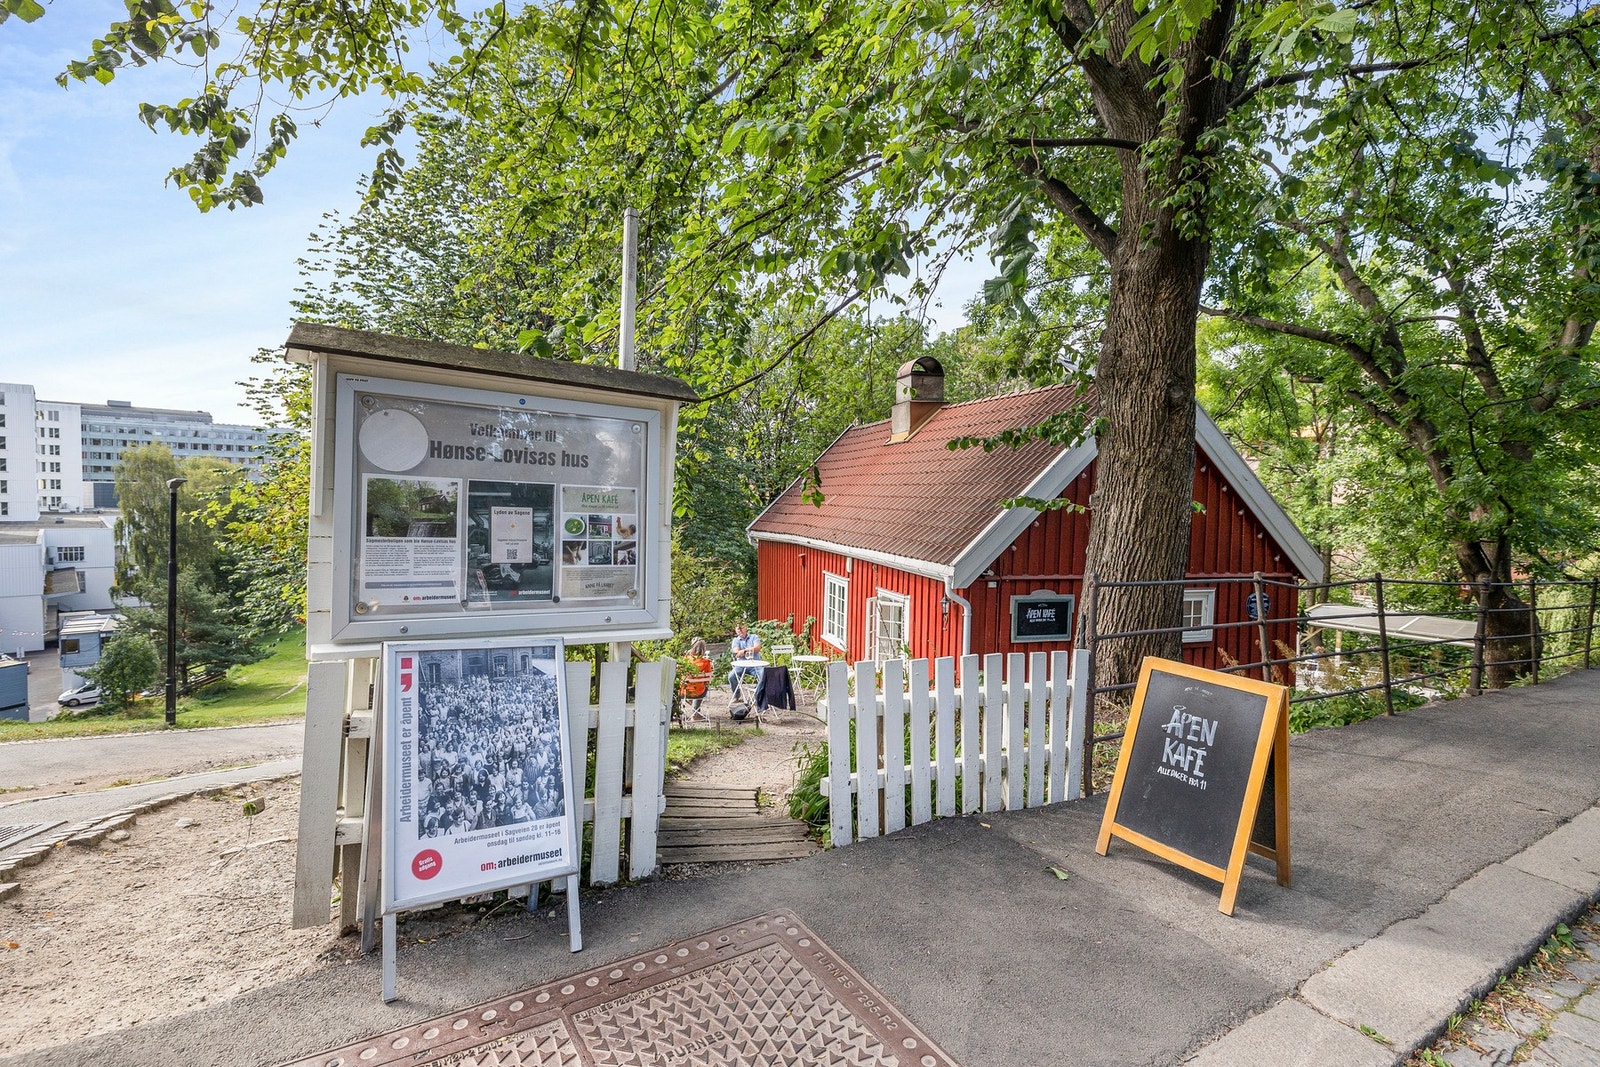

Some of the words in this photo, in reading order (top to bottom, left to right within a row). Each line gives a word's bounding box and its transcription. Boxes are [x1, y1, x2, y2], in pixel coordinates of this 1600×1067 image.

[545, 430, 557, 442] til
[430, 440, 556, 466] Hønse-ovisas
[561, 450, 589, 468] hus
[581, 492, 600, 503] ÅPEN
[400, 697, 413, 725] åpent
[402, 727, 412, 738] er
[1161, 705, 1219, 746] ÅPEN
[1162, 737, 1207, 778] KAFÉ
[400, 740, 412, 822] Arbeidermuseet
[454, 832, 500, 845] Arbeidermuseet
[505, 826, 530, 836] Sagveien
[546, 821, 561, 830] åpent
[487, 838, 508, 847] onsdag
[419, 856, 433, 865] Gratis
[498, 848, 562, 868] arbeidermuseet
[812, 951, 854, 989] FURNES
[852, 988, 898, 1031] 7295-R2
[665, 1031, 726, 1062] FURNES
